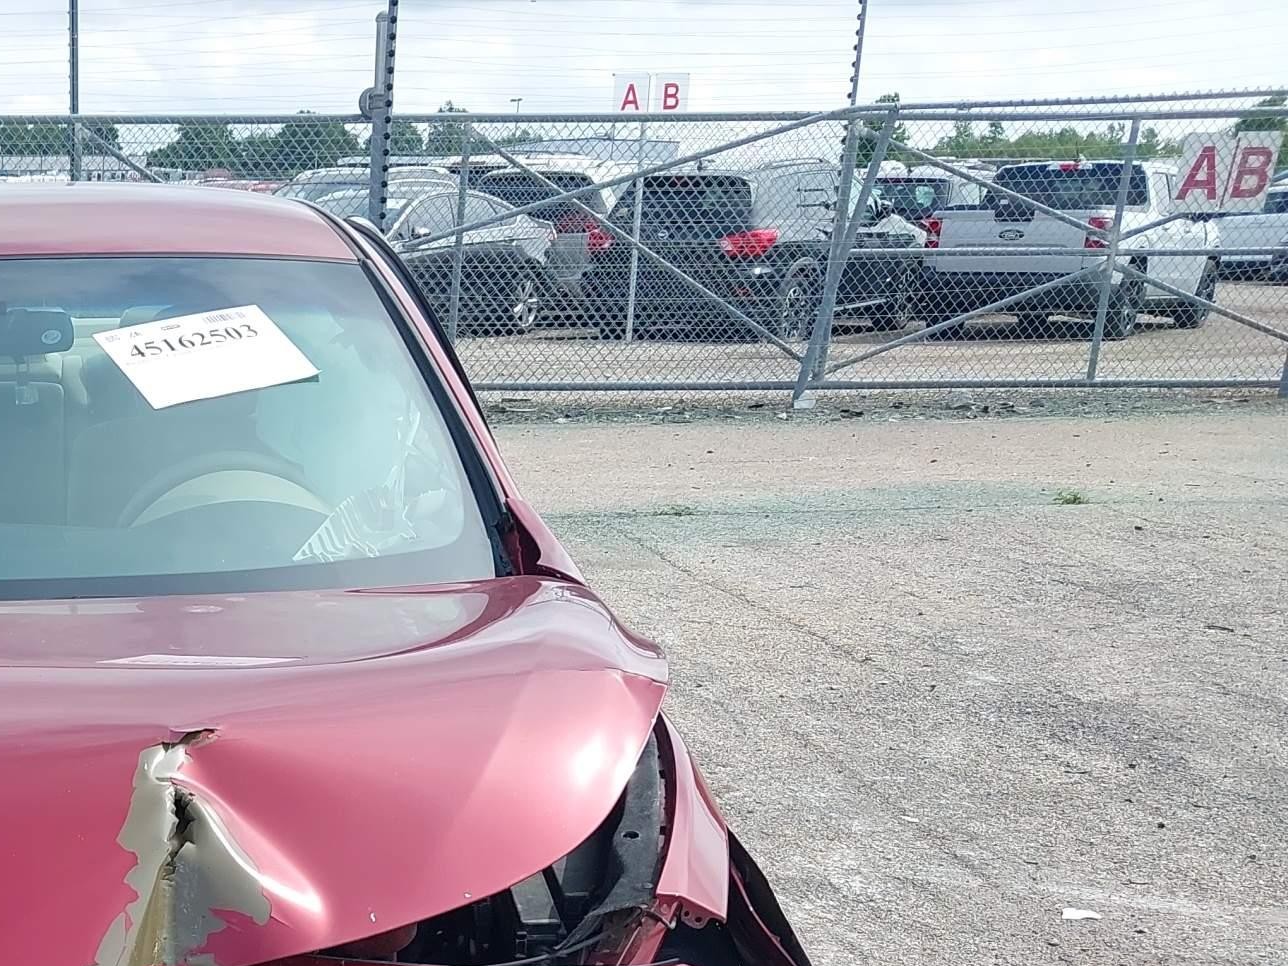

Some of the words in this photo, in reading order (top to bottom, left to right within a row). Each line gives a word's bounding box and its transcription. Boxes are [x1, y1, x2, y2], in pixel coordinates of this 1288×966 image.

[620, 83, 640, 112] A
[663, 83, 680, 110] B
[1175, 146, 1217, 200] A
[1230, 147, 1273, 198] B
[130, 324, 259, 358] 45162503
